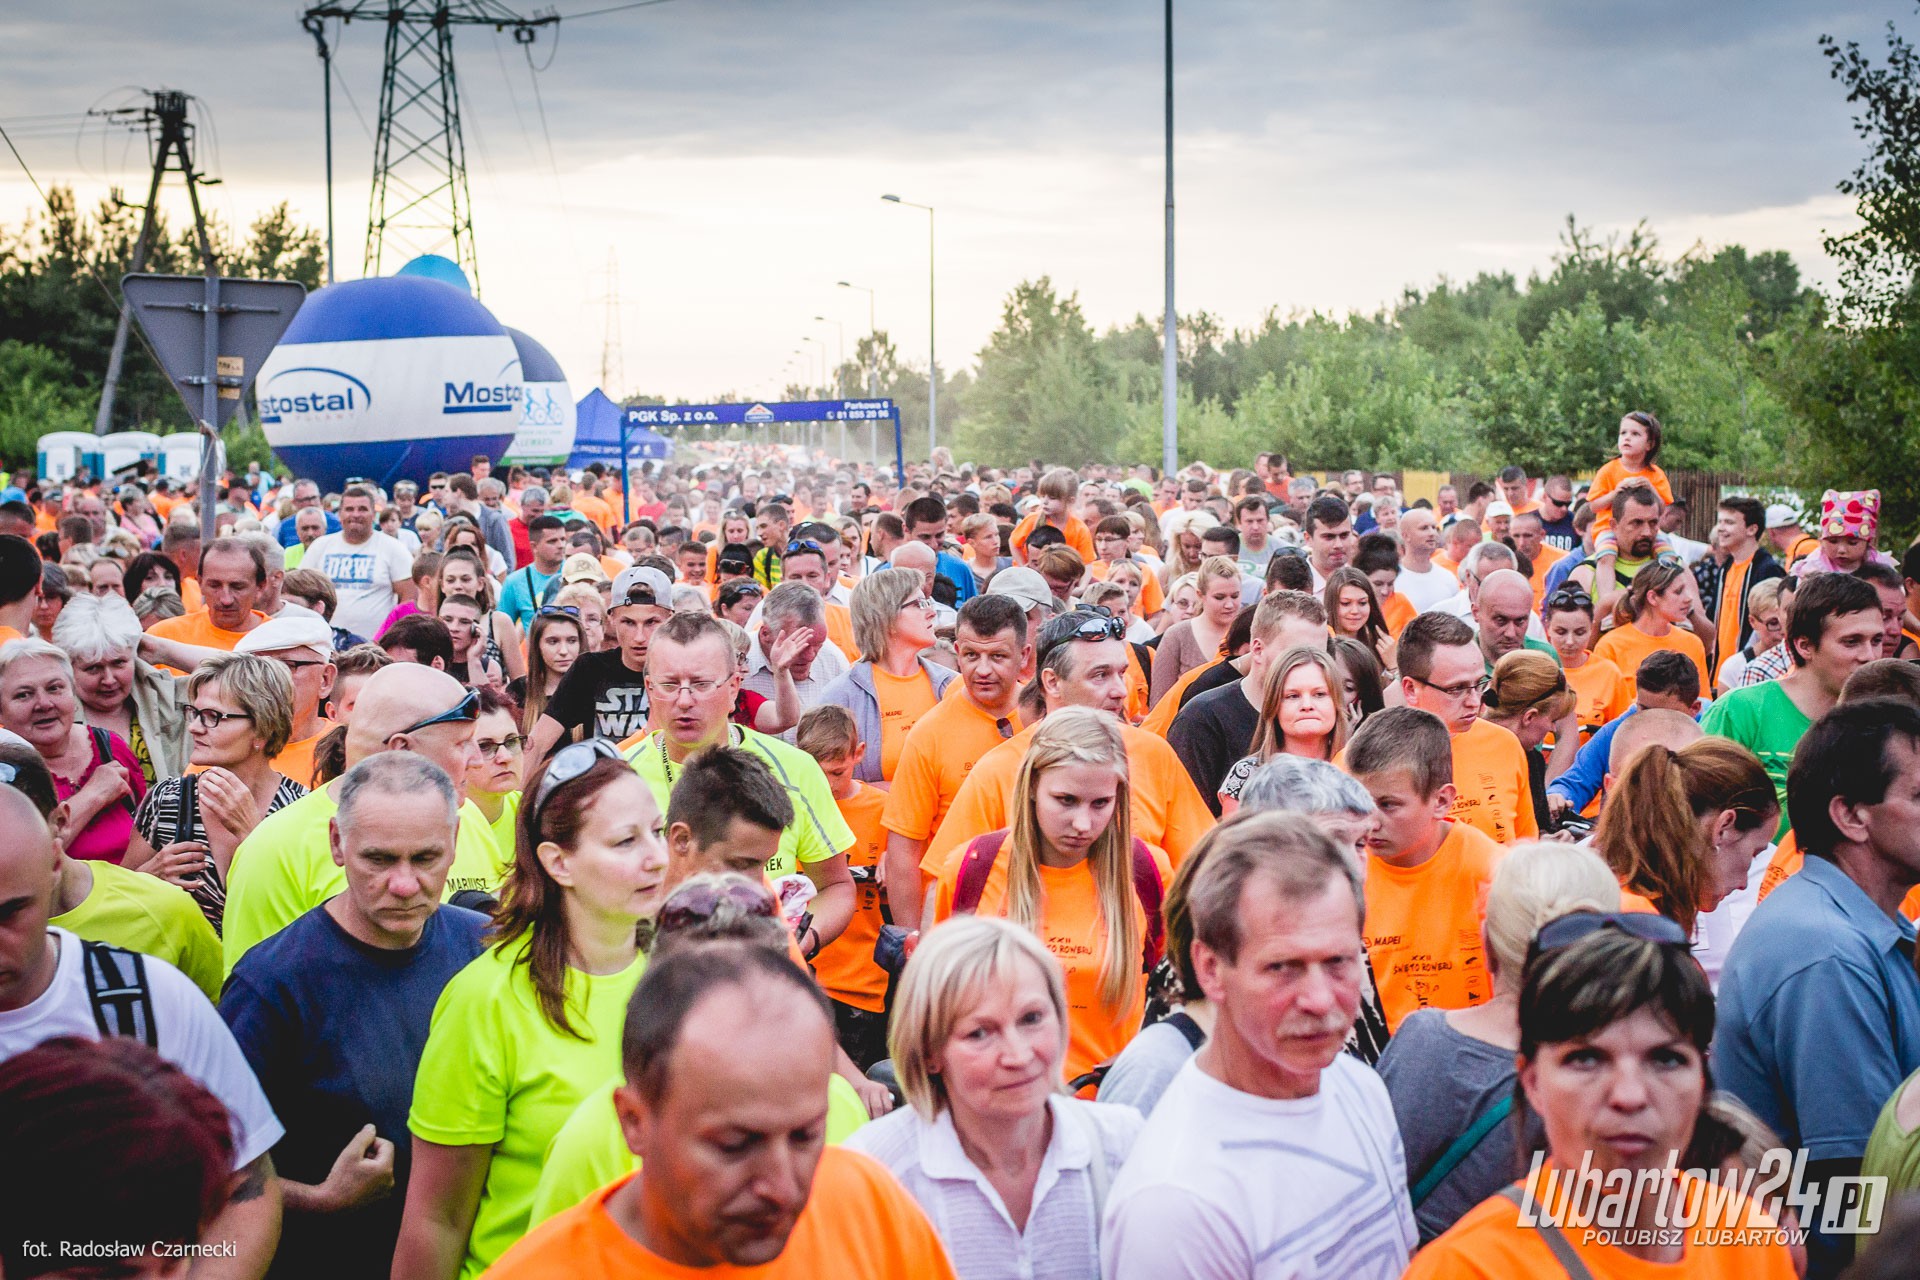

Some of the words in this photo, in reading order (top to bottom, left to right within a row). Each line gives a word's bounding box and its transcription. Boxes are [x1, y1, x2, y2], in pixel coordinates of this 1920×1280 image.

[629, 410, 658, 422] PGK
[660, 410, 681, 424] Sp.
[683, 412, 692, 421] z
[694, 411, 718, 421] o.o.
[328, 556, 372, 579] DRW
[596, 687, 649, 712] STA
[597, 713, 649, 737] WA
[447, 878, 490, 892] MARIUSZ
[1374, 936, 1401, 946] MAPEI
